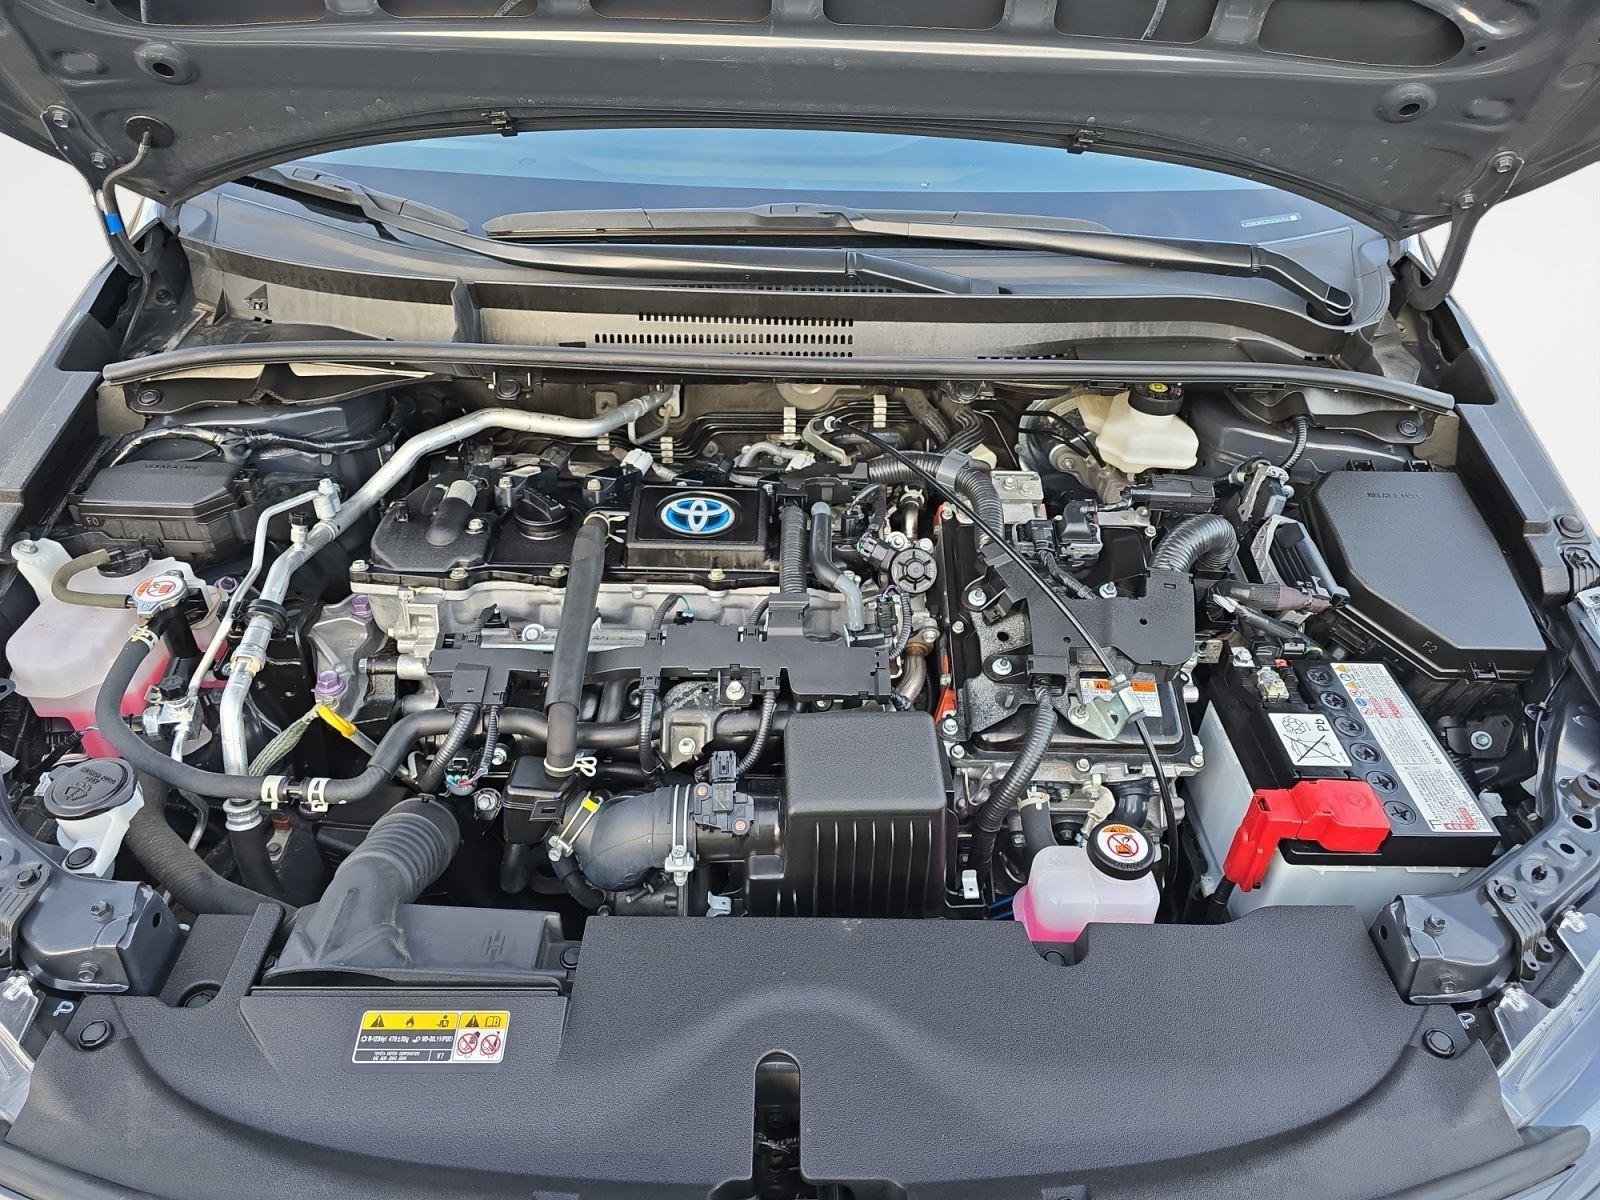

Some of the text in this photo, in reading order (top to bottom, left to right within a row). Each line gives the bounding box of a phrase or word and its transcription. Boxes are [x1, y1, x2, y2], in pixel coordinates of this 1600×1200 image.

[1422, 640, 1438, 654] F2
[1314, 718, 1330, 732] Pb
[52, 1001, 75, 1017] P
[1457, 1012, 1476, 1030] P
